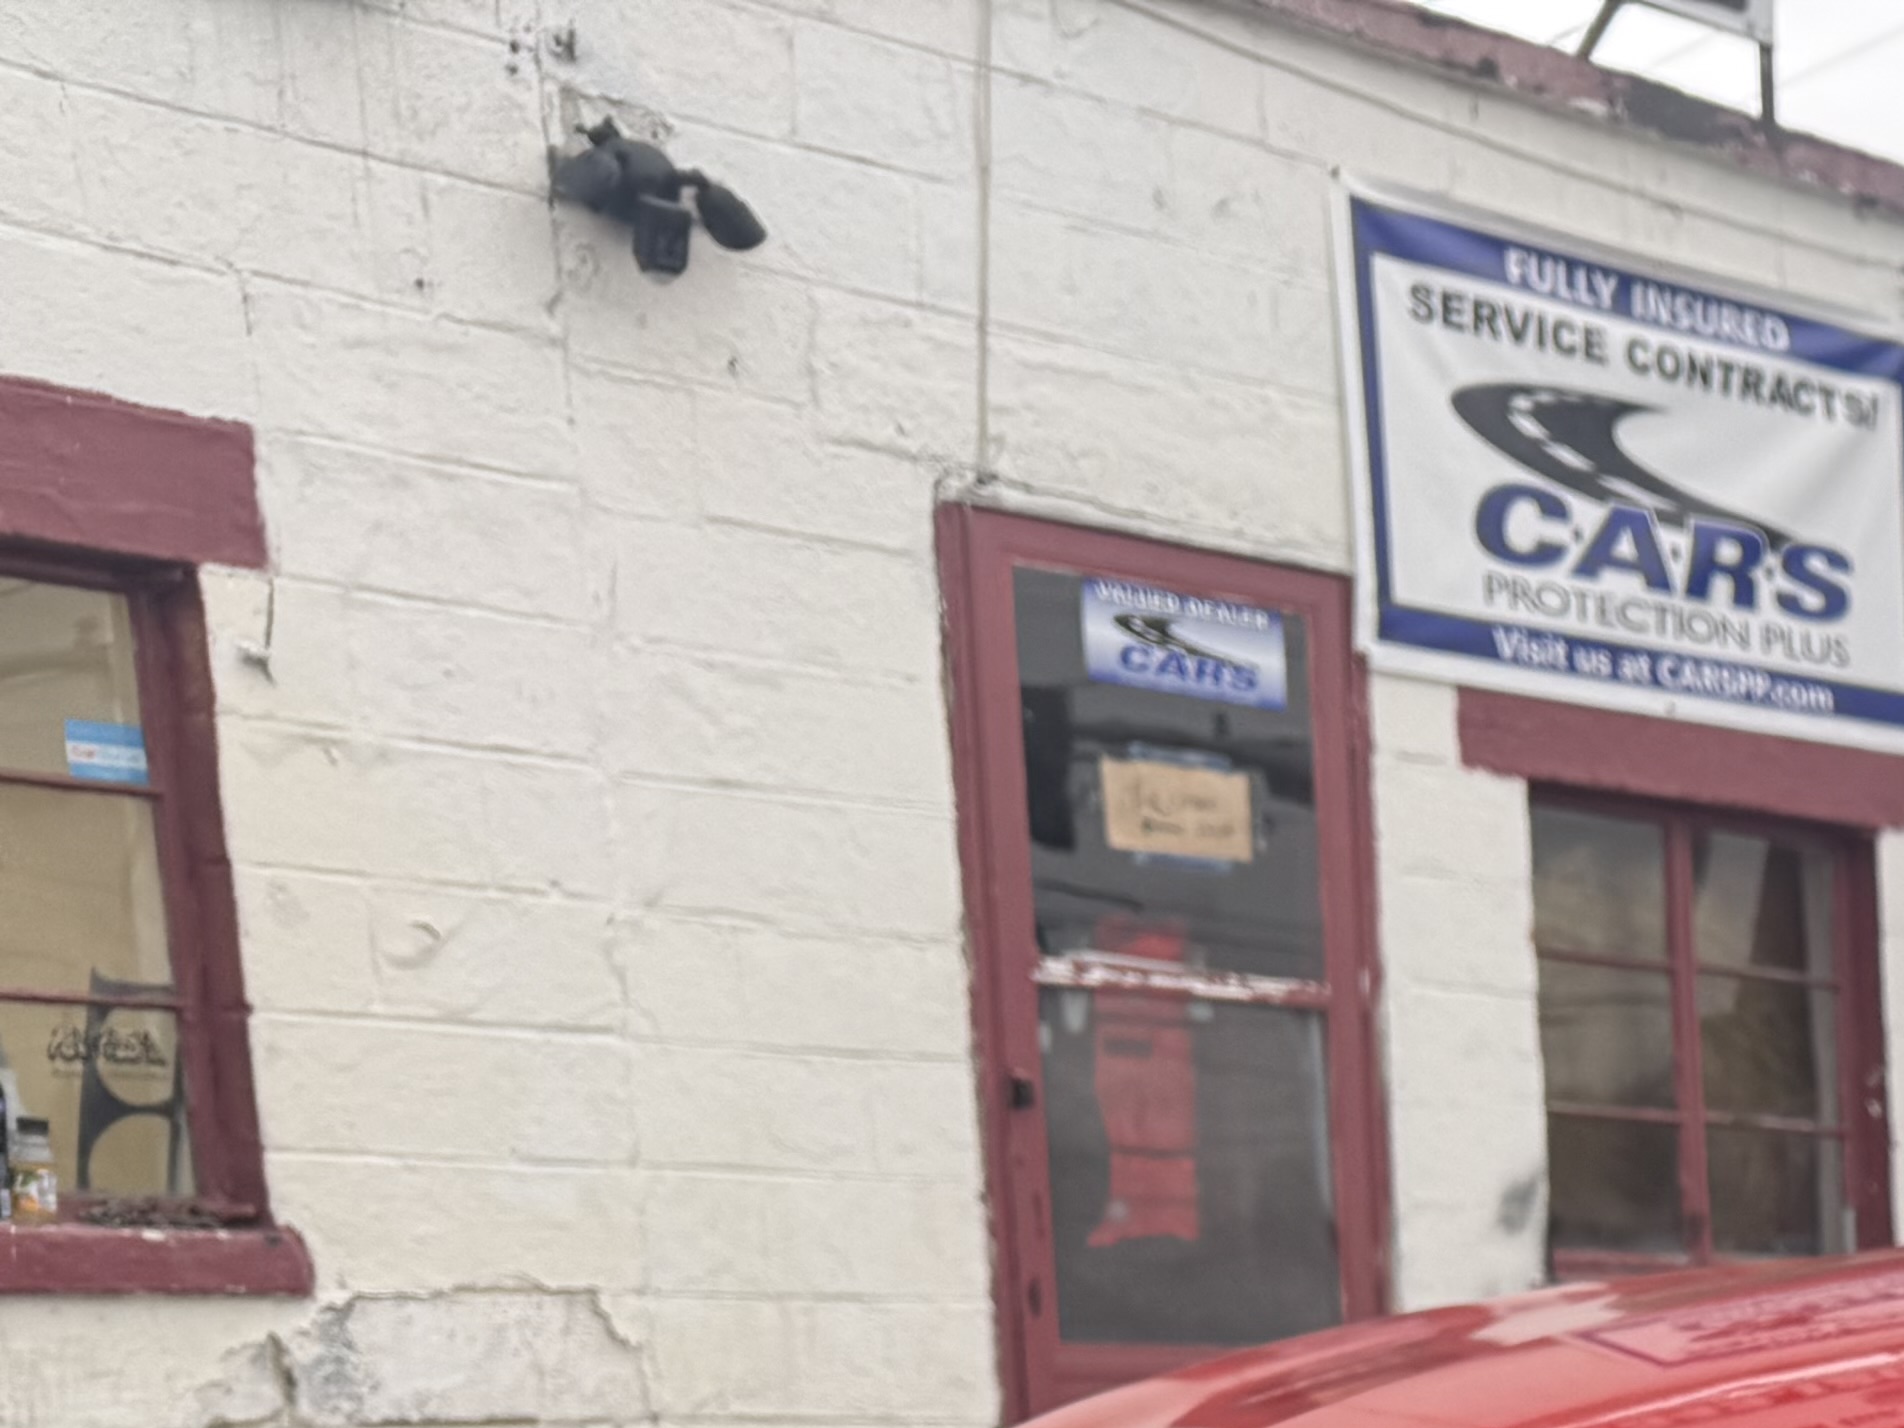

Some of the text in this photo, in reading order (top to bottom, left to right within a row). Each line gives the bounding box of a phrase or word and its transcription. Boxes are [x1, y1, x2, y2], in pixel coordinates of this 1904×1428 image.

[1409, 281, 1609, 366] SERVICE
[1504, 246, 1791, 351] FULLY INSURED
[1482, 570, 1850, 668] PROTECTION PLUS
[1492, 624, 1569, 672] Visit
[1572, 645, 1613, 678] us
[1616, 650, 1652, 684] at
